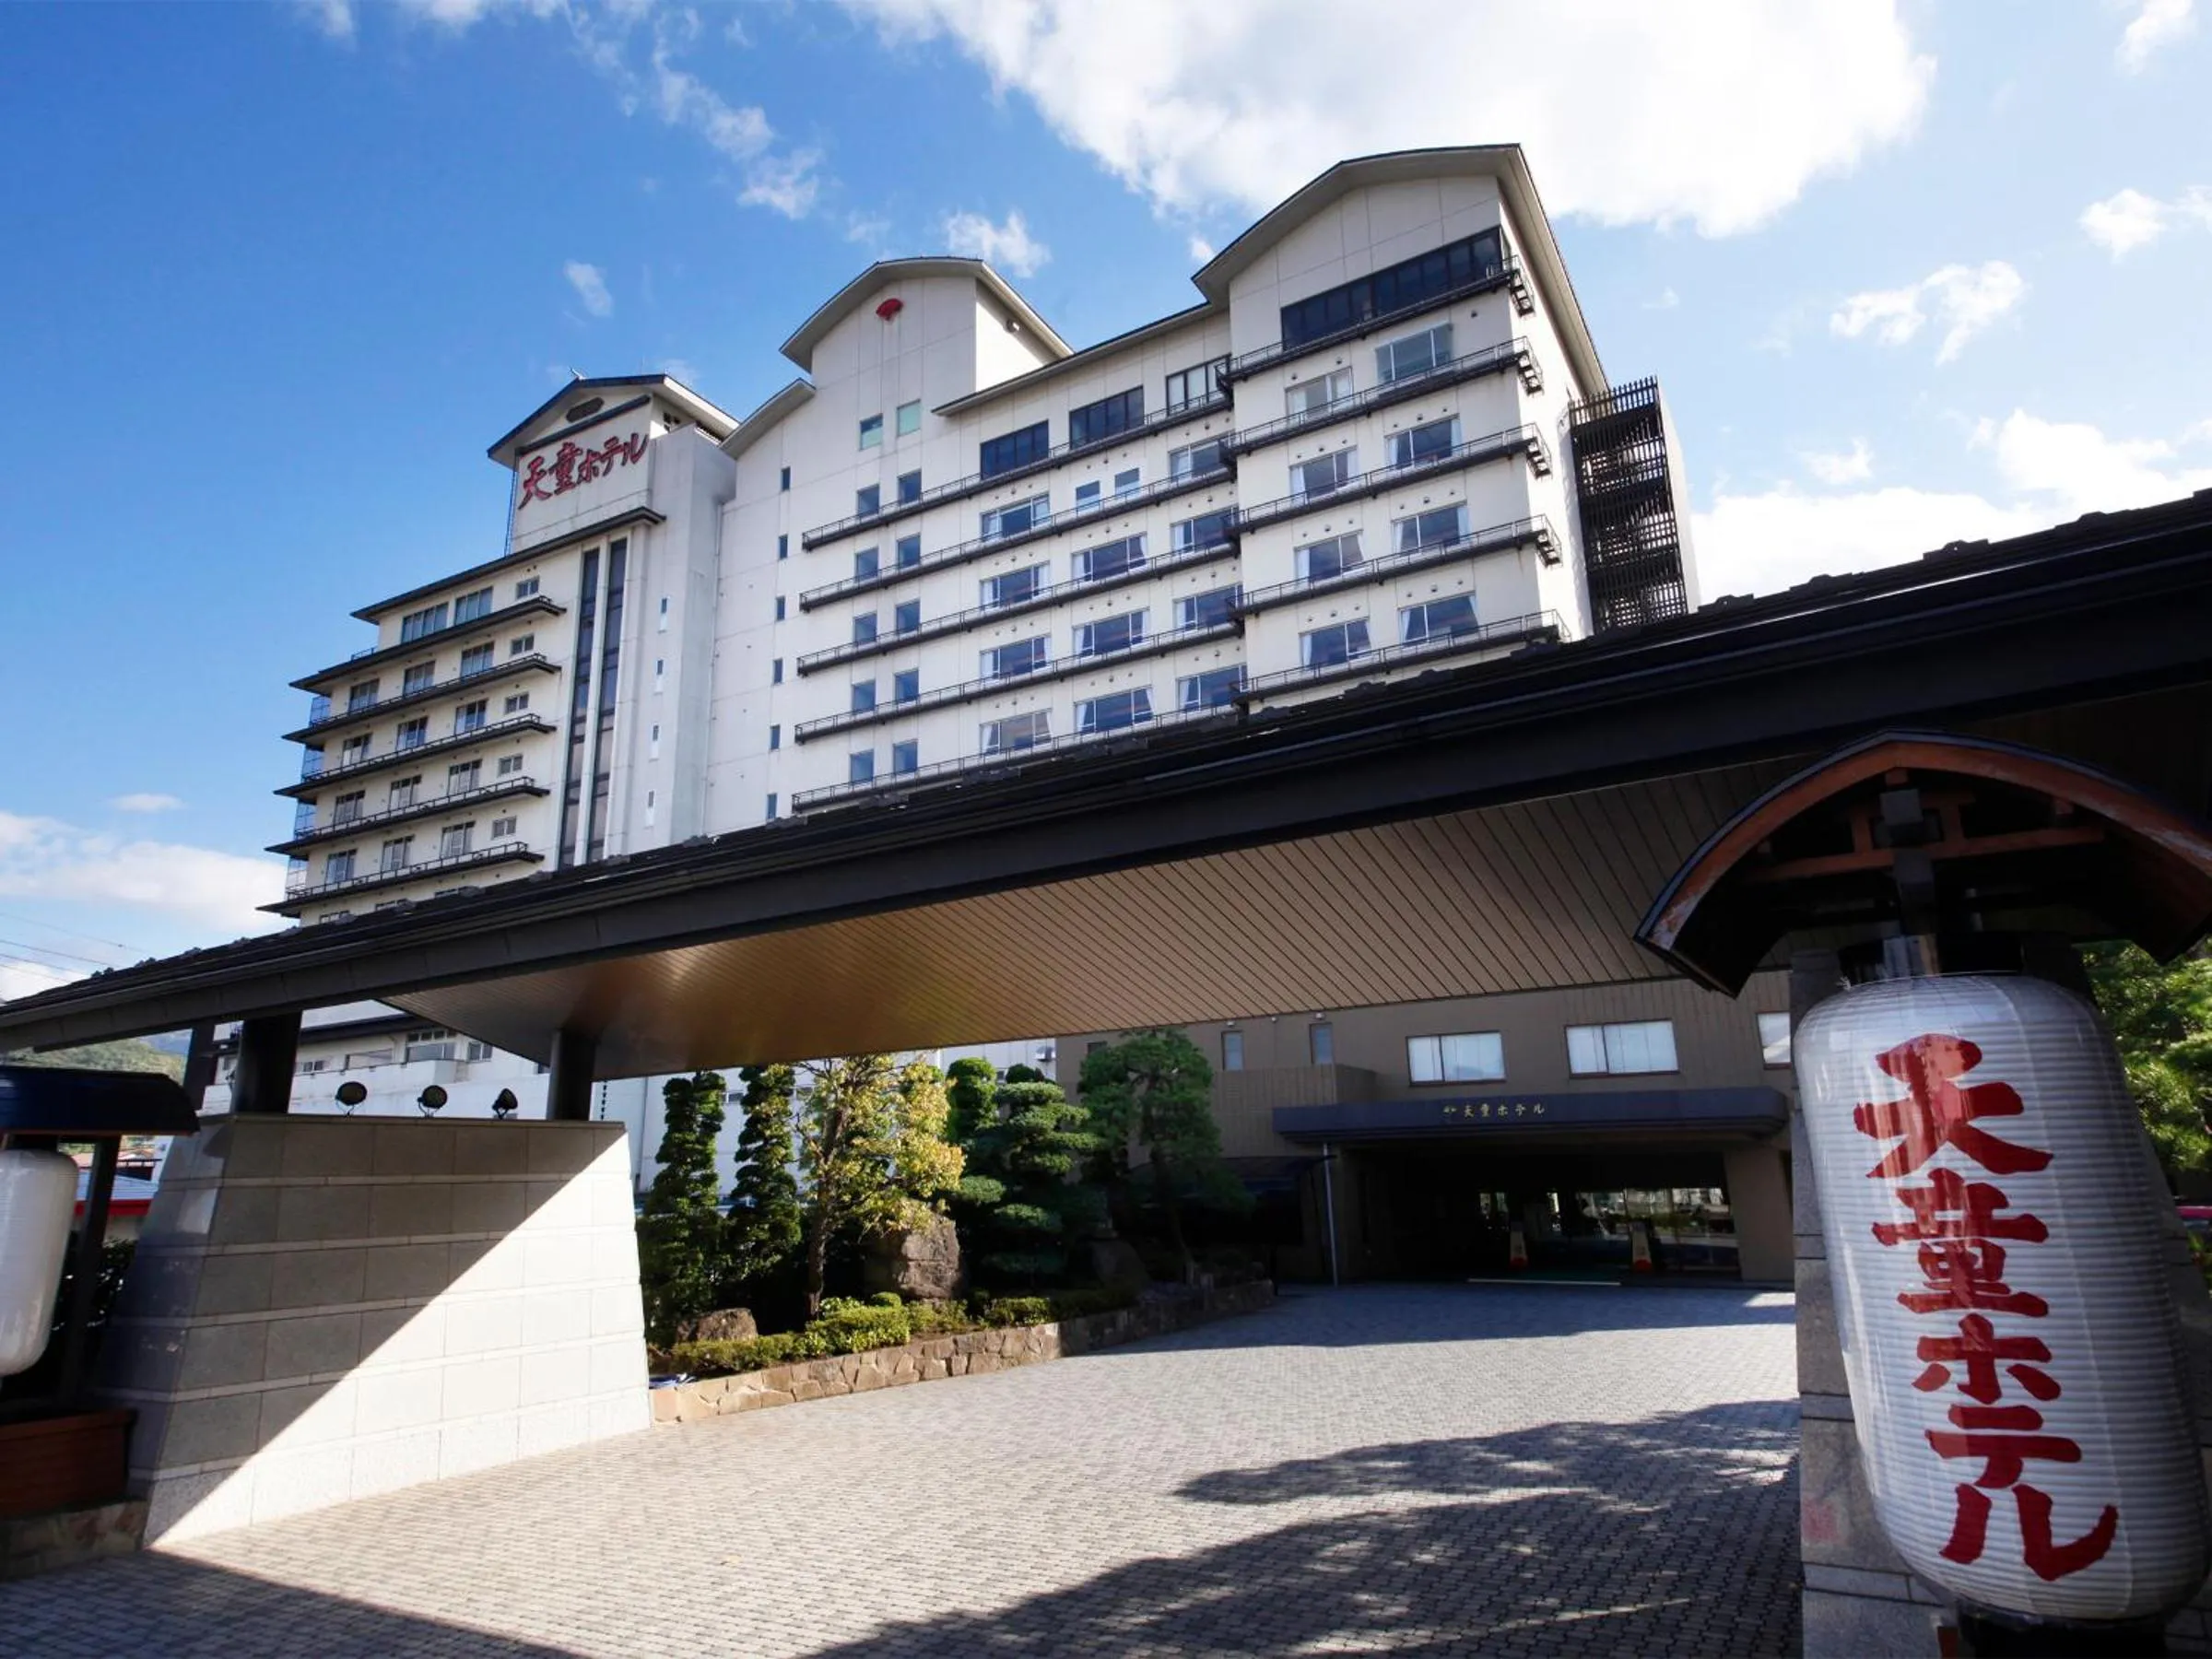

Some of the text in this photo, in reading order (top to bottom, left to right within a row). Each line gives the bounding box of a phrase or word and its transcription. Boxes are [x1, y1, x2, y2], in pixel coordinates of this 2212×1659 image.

[518, 432, 648, 510] 天童ホテル
[1853, 1032, 2118, 1582] 天童ホテル
